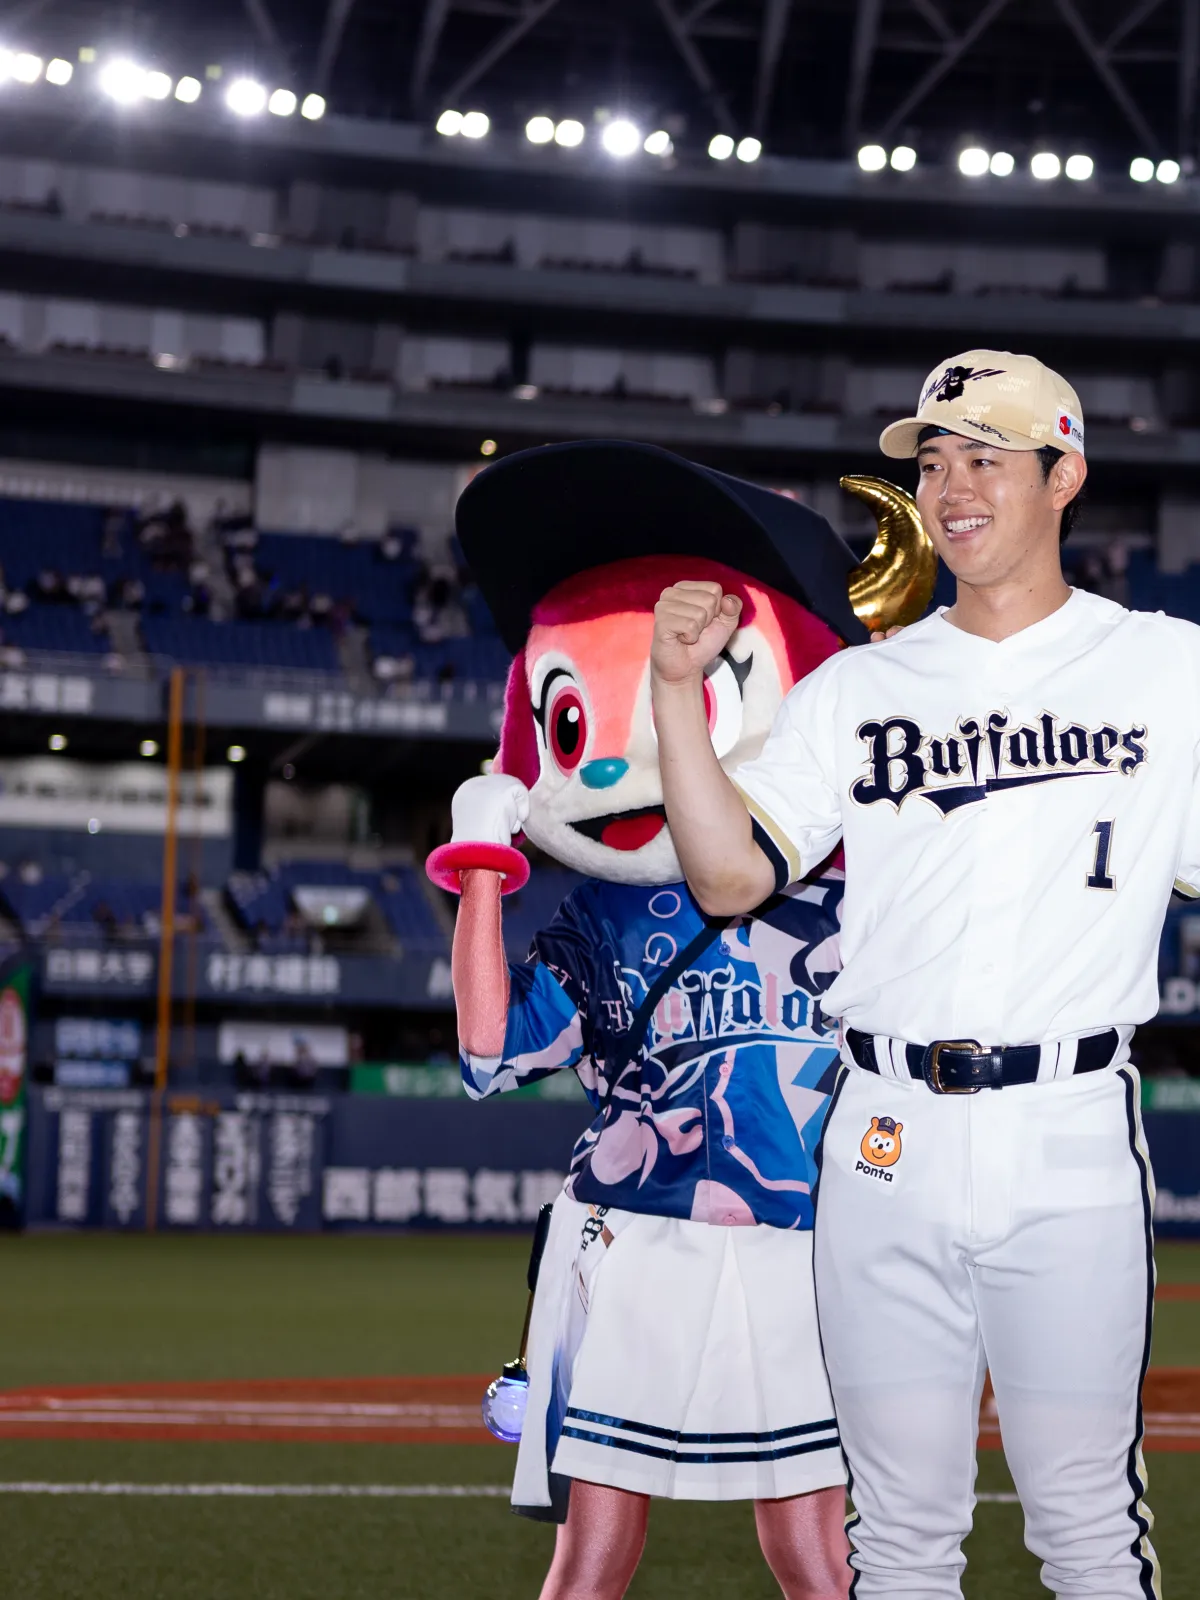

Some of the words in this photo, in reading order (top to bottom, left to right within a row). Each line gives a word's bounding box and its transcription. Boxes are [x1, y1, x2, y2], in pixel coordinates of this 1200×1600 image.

[849, 706, 1150, 818] Buffaloes
[1085, 817, 1117, 891] 1
[855, 1160, 894, 1182] Ponta
